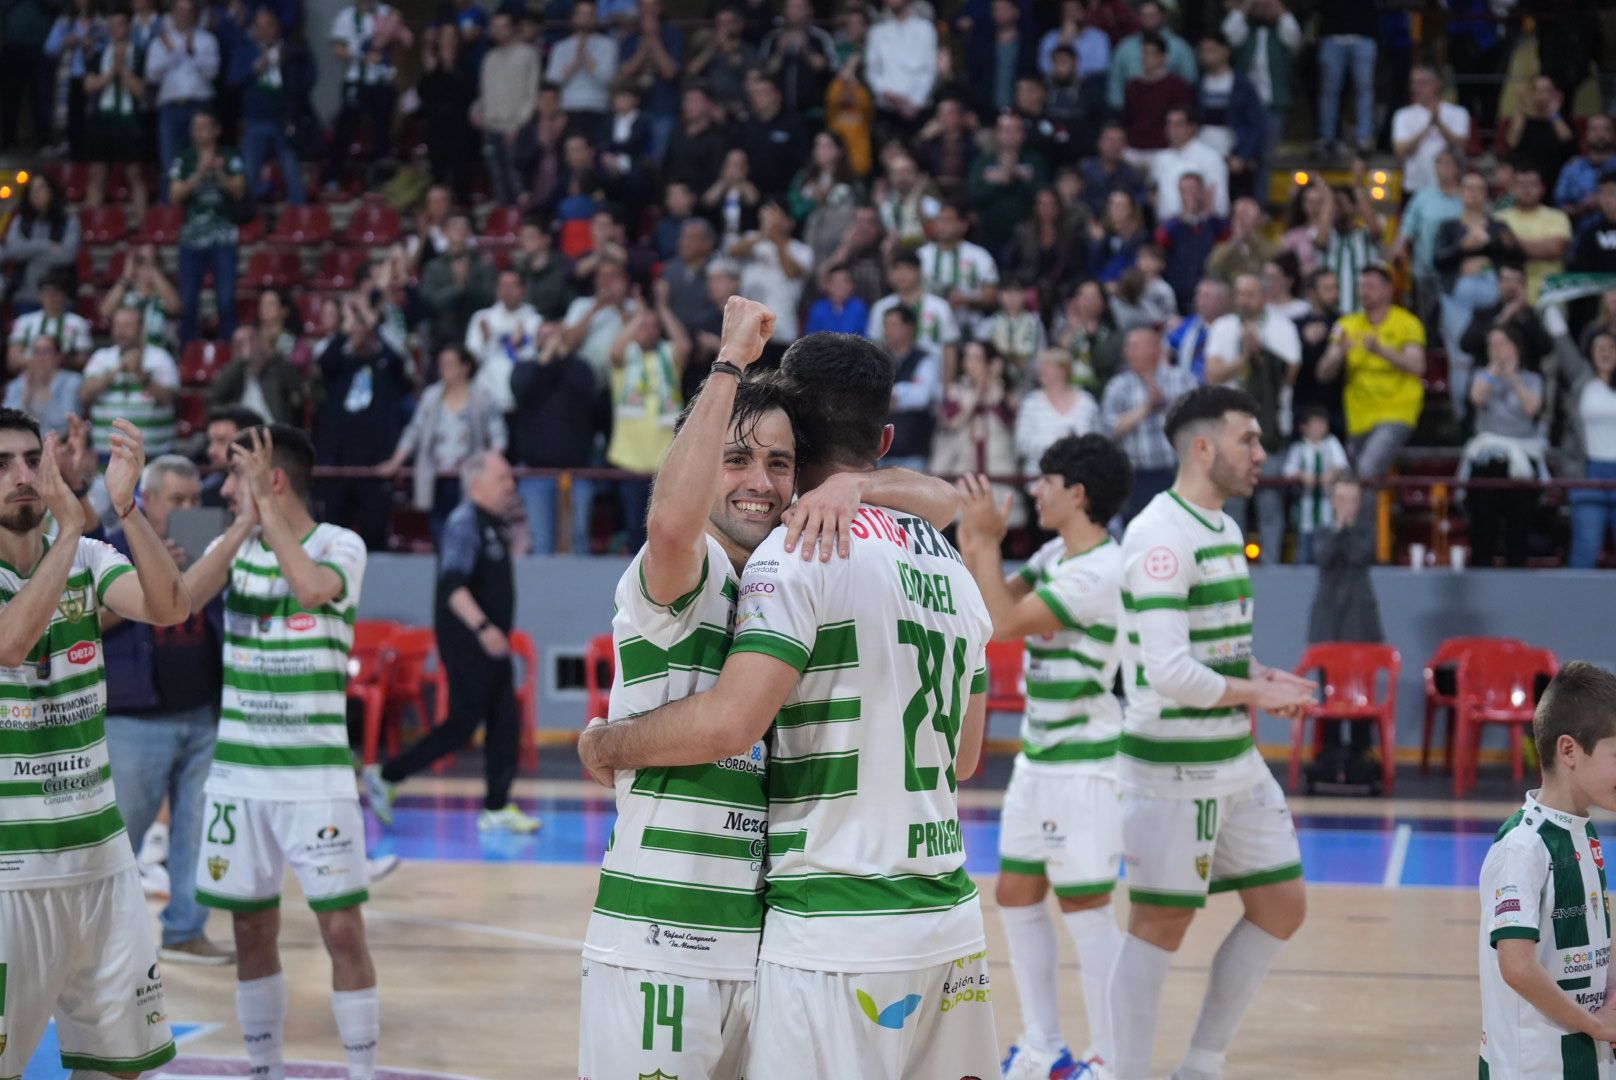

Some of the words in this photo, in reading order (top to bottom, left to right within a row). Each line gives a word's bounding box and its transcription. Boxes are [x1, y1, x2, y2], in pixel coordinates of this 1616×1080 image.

[897, 619, 967, 794] 24
[207, 802, 237, 845] 25
[908, 818, 963, 859] PRIEGO
[1194, 798, 1218, 842] 10
[640, 981, 685, 1053] 14
